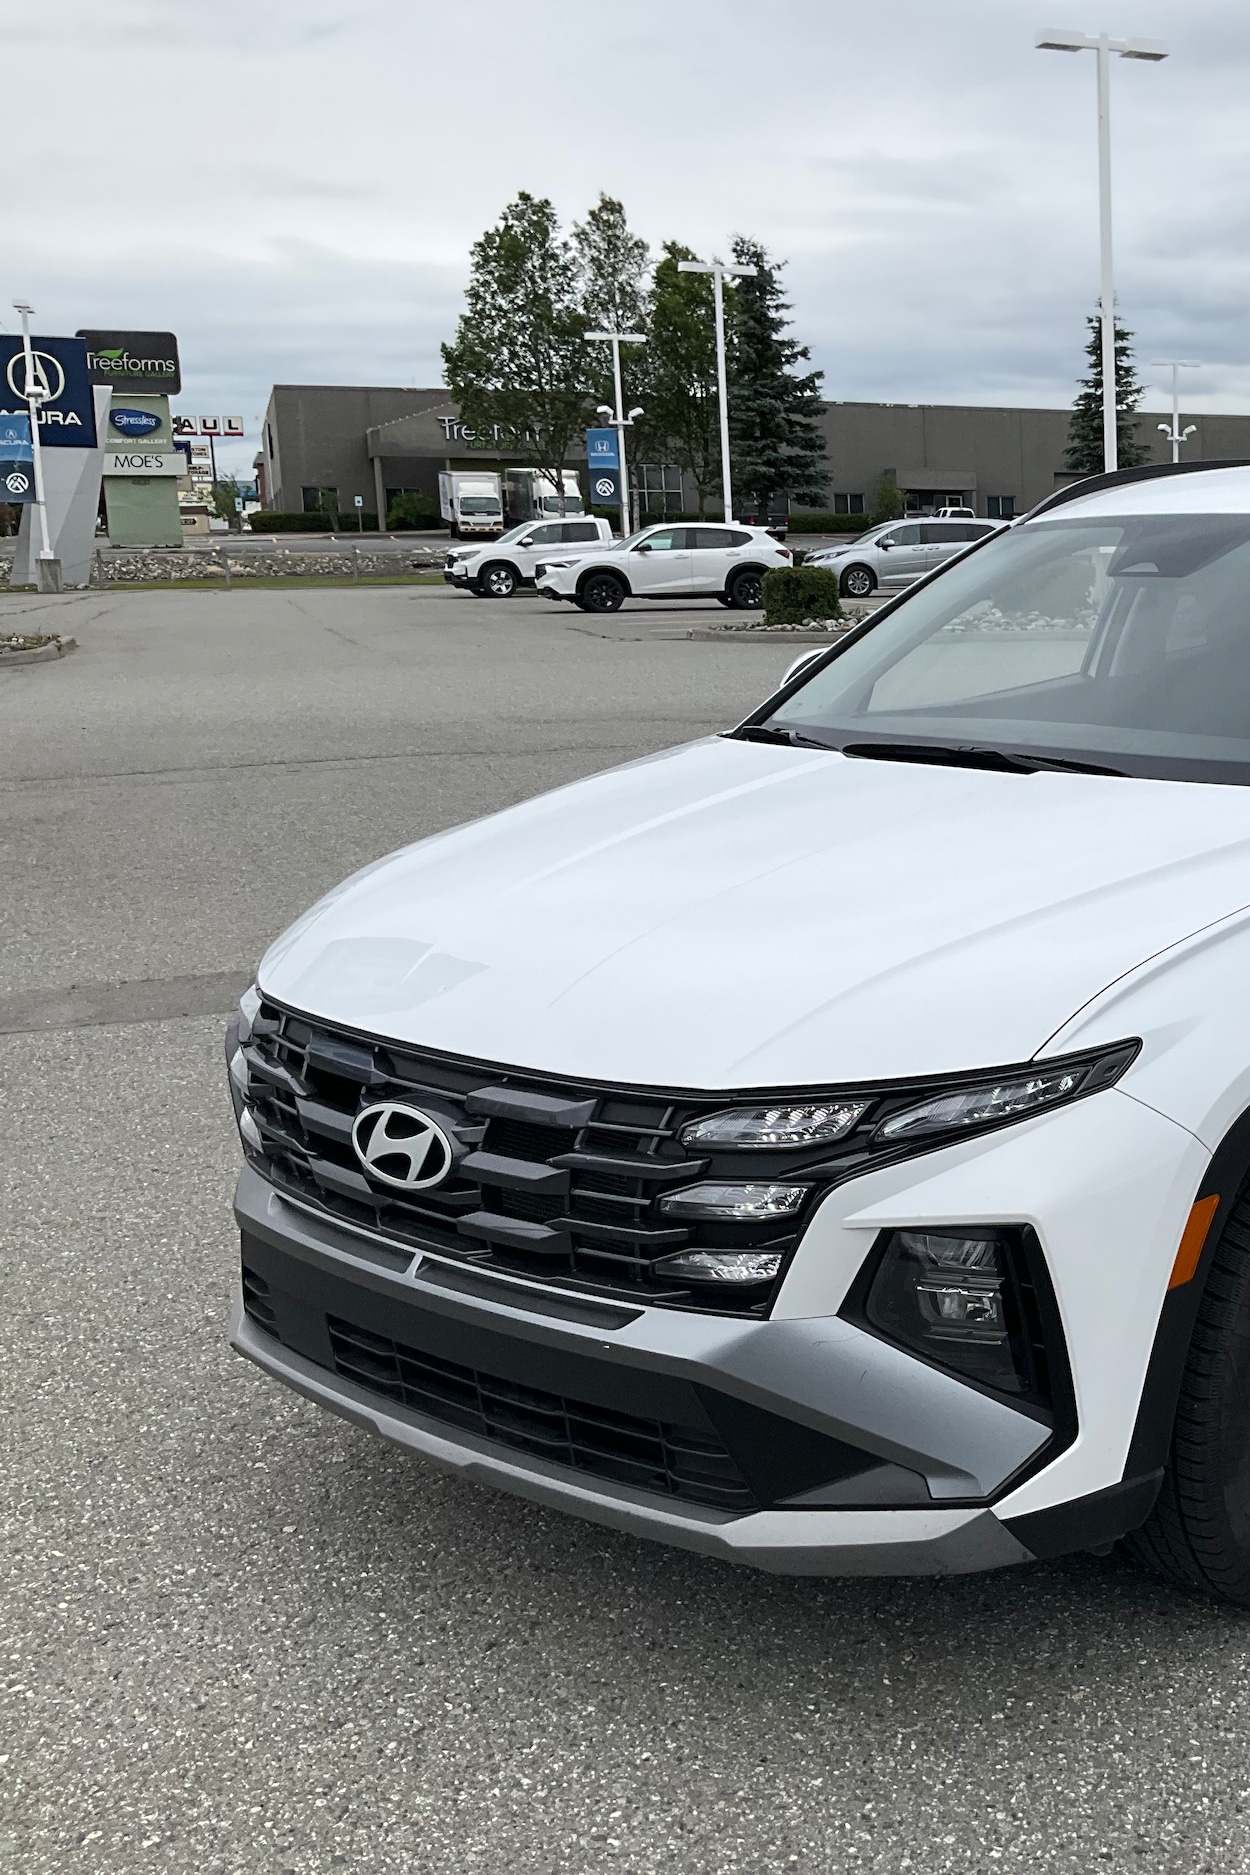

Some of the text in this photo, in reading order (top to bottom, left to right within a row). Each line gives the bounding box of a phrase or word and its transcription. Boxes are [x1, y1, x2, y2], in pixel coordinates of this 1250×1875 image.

[86, 352, 176, 372] Treeforms
[114, 414, 157, 426] Stressless
[114, 455, 163, 468] MOE'S
